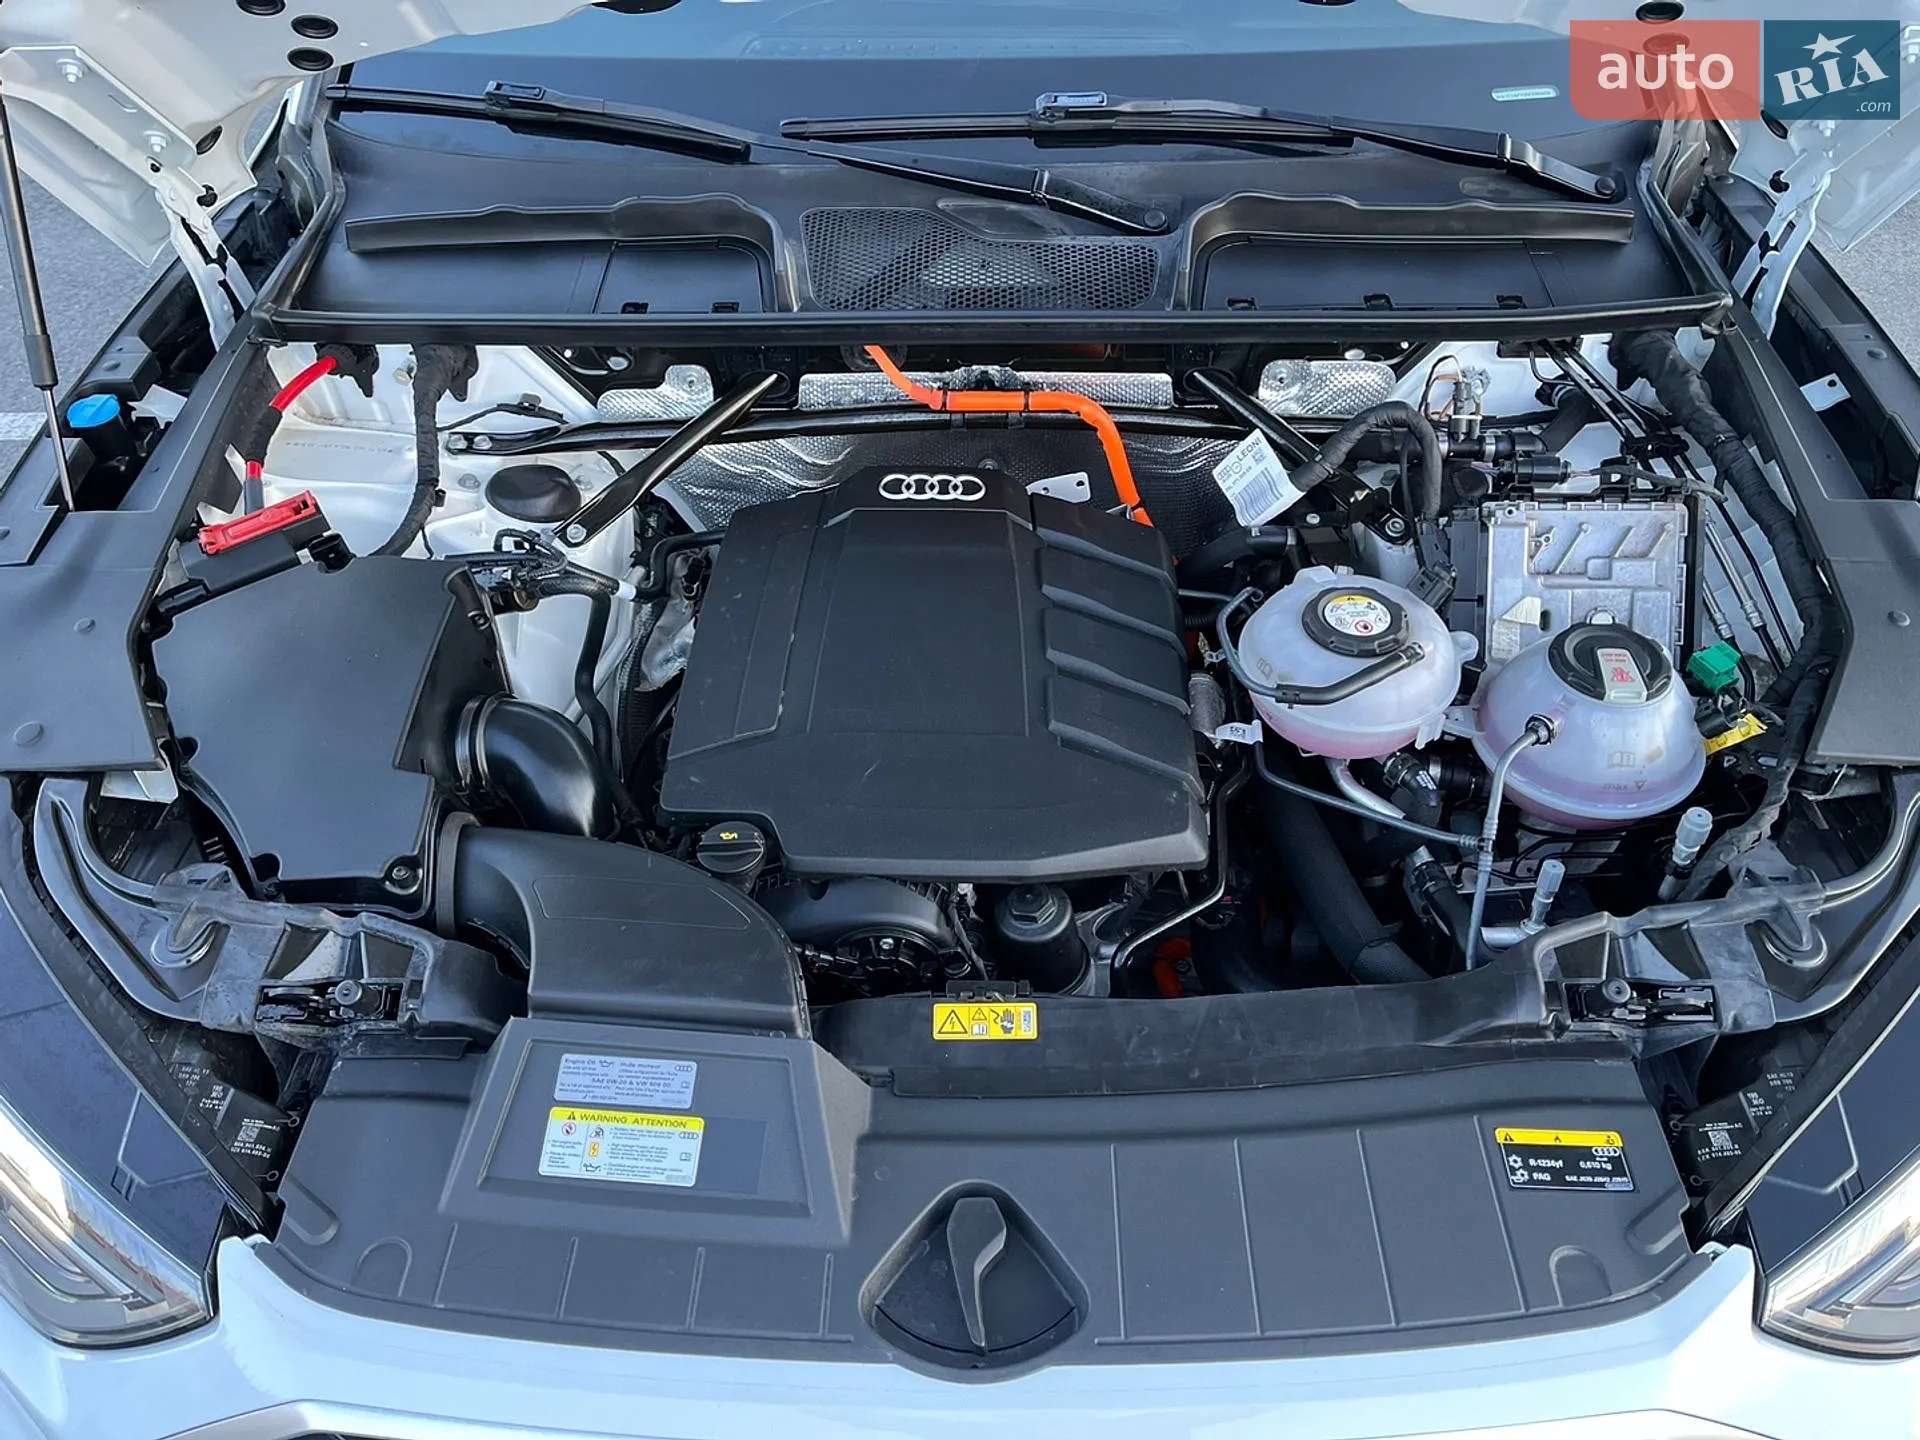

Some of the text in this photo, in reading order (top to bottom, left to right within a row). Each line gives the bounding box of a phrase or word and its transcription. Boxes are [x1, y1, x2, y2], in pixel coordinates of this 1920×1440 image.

[1237, 437, 1263, 462] LEONI
[580, 1113, 687, 1129] WARNING ATTENTION
[1532, 1172, 1551, 1181] PAG
